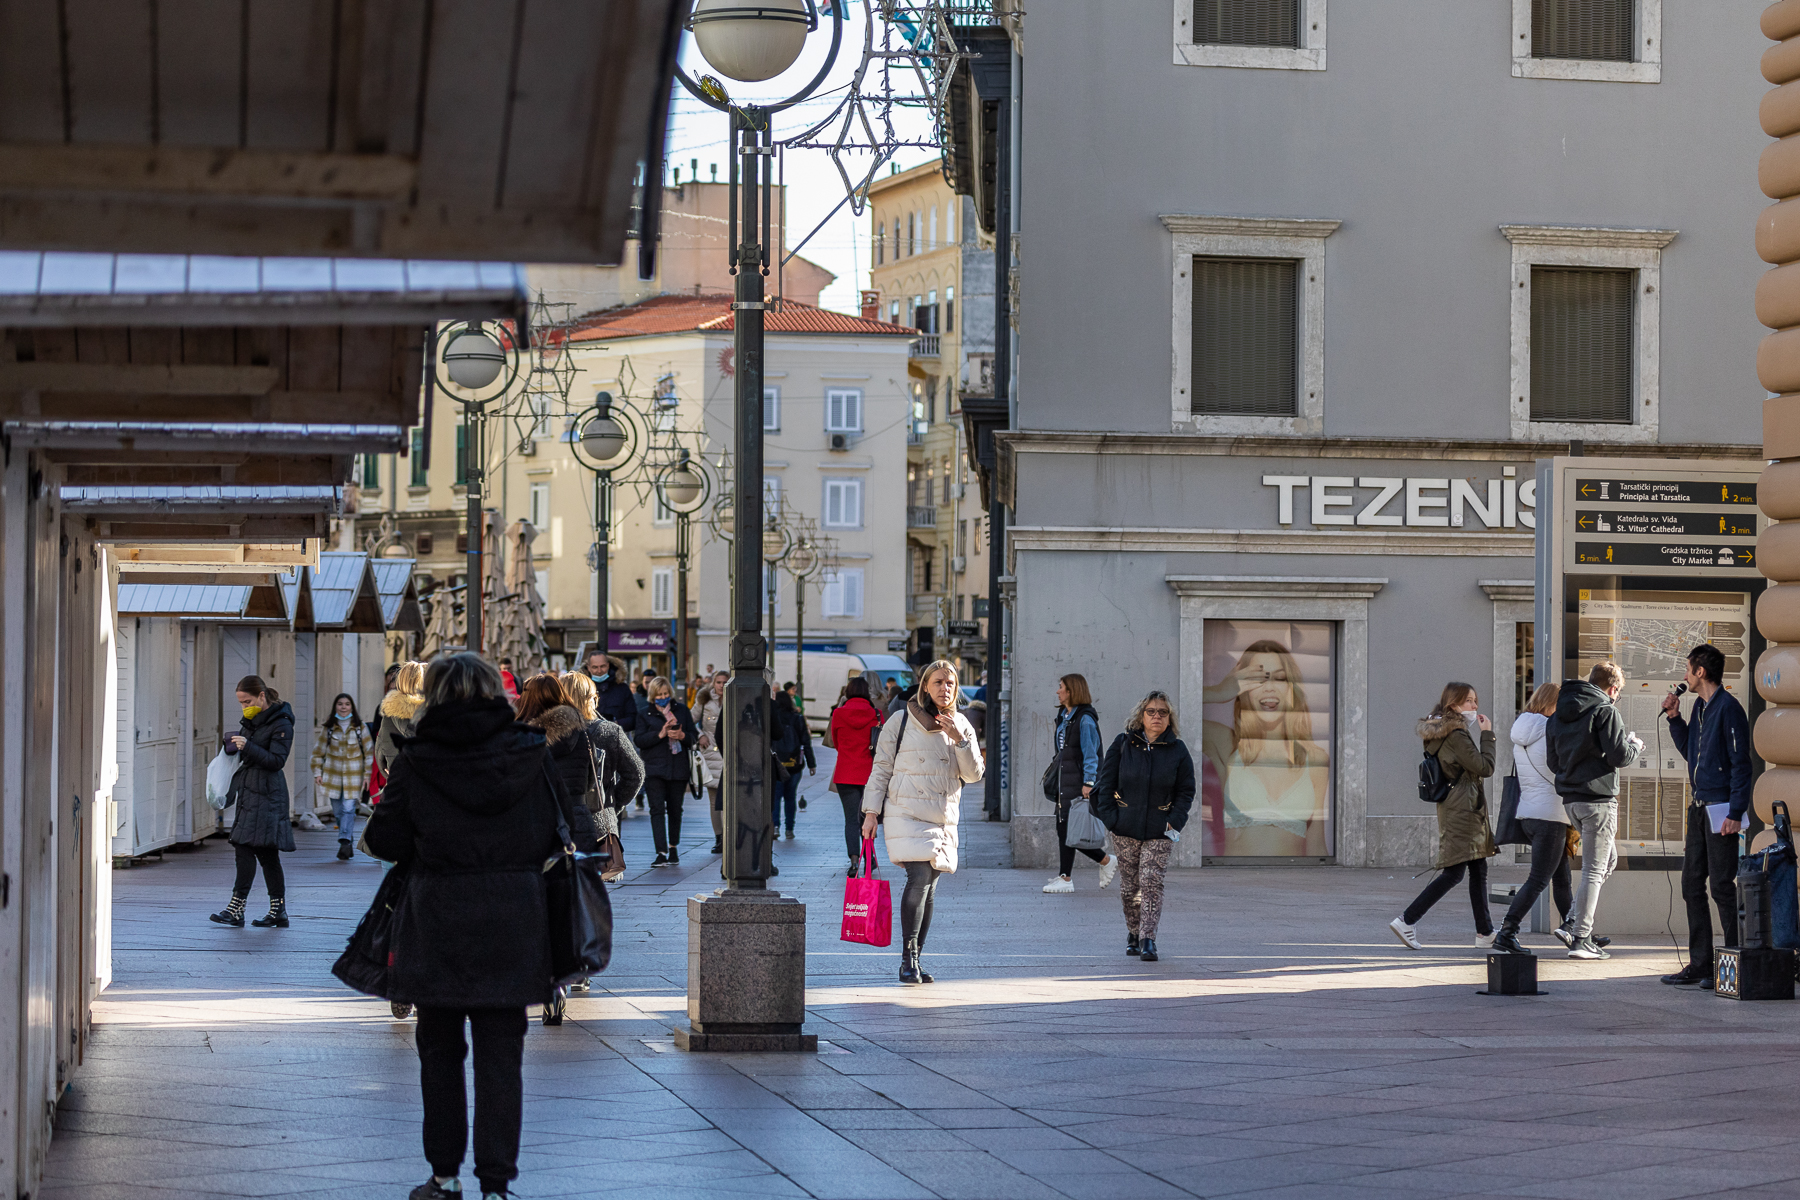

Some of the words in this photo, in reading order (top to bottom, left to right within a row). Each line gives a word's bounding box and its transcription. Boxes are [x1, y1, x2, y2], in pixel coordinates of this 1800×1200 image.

[1620, 483, 1651, 491] Tarsatički
[1653, 484, 1679, 493] principij
[1620, 493, 1649, 502] Principia
[1733, 495, 1739, 503] 2
[1617, 515, 1649, 523] Katedrala
[1662, 516, 1678, 524] Vida
[1731, 526, 1737, 534] 3
[1738, 527, 1752, 535] min.
[1661, 546, 1689, 555] Gradska
[1690, 547, 1713, 555] tržnica
[1580, 554, 1586, 562] 5
[1672, 557, 1686, 566] City
[1688, 557, 1713, 565] Market
